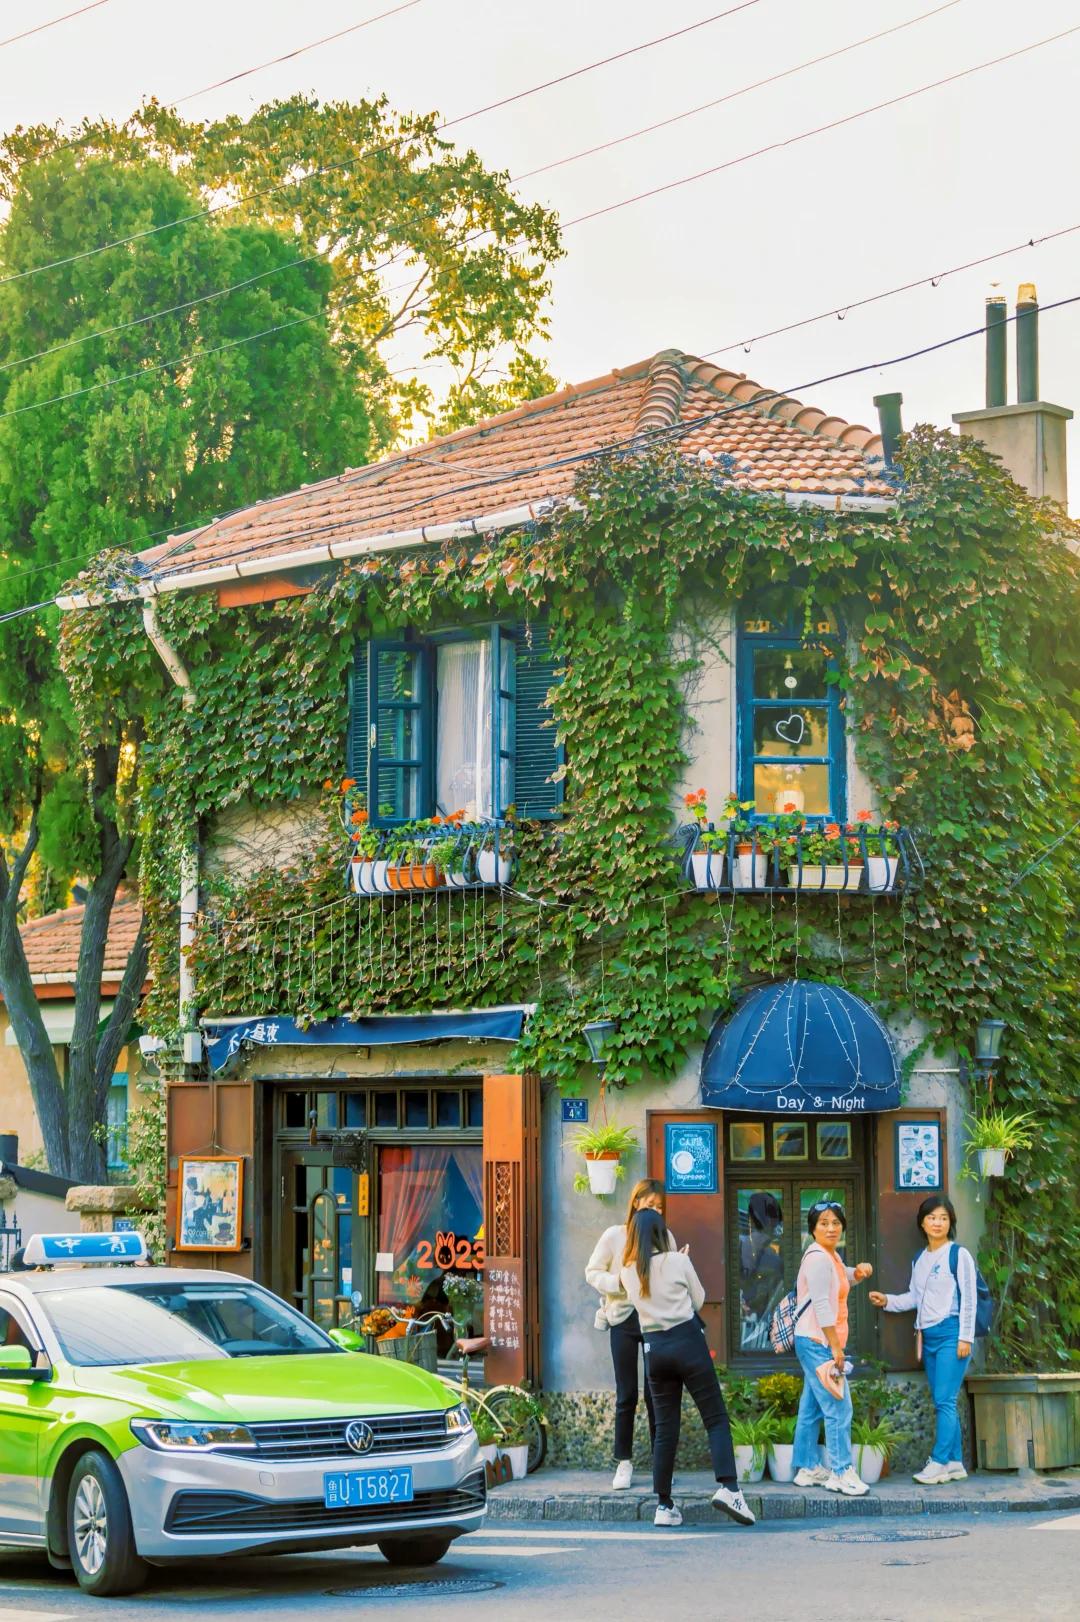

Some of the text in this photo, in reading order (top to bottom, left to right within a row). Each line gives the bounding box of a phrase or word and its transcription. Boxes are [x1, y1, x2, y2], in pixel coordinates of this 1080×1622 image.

[776, 1095, 865, 1112] Day & Night
[569, 1108, 575, 1119] 4
[416, 1231, 485, 1269] 2023
